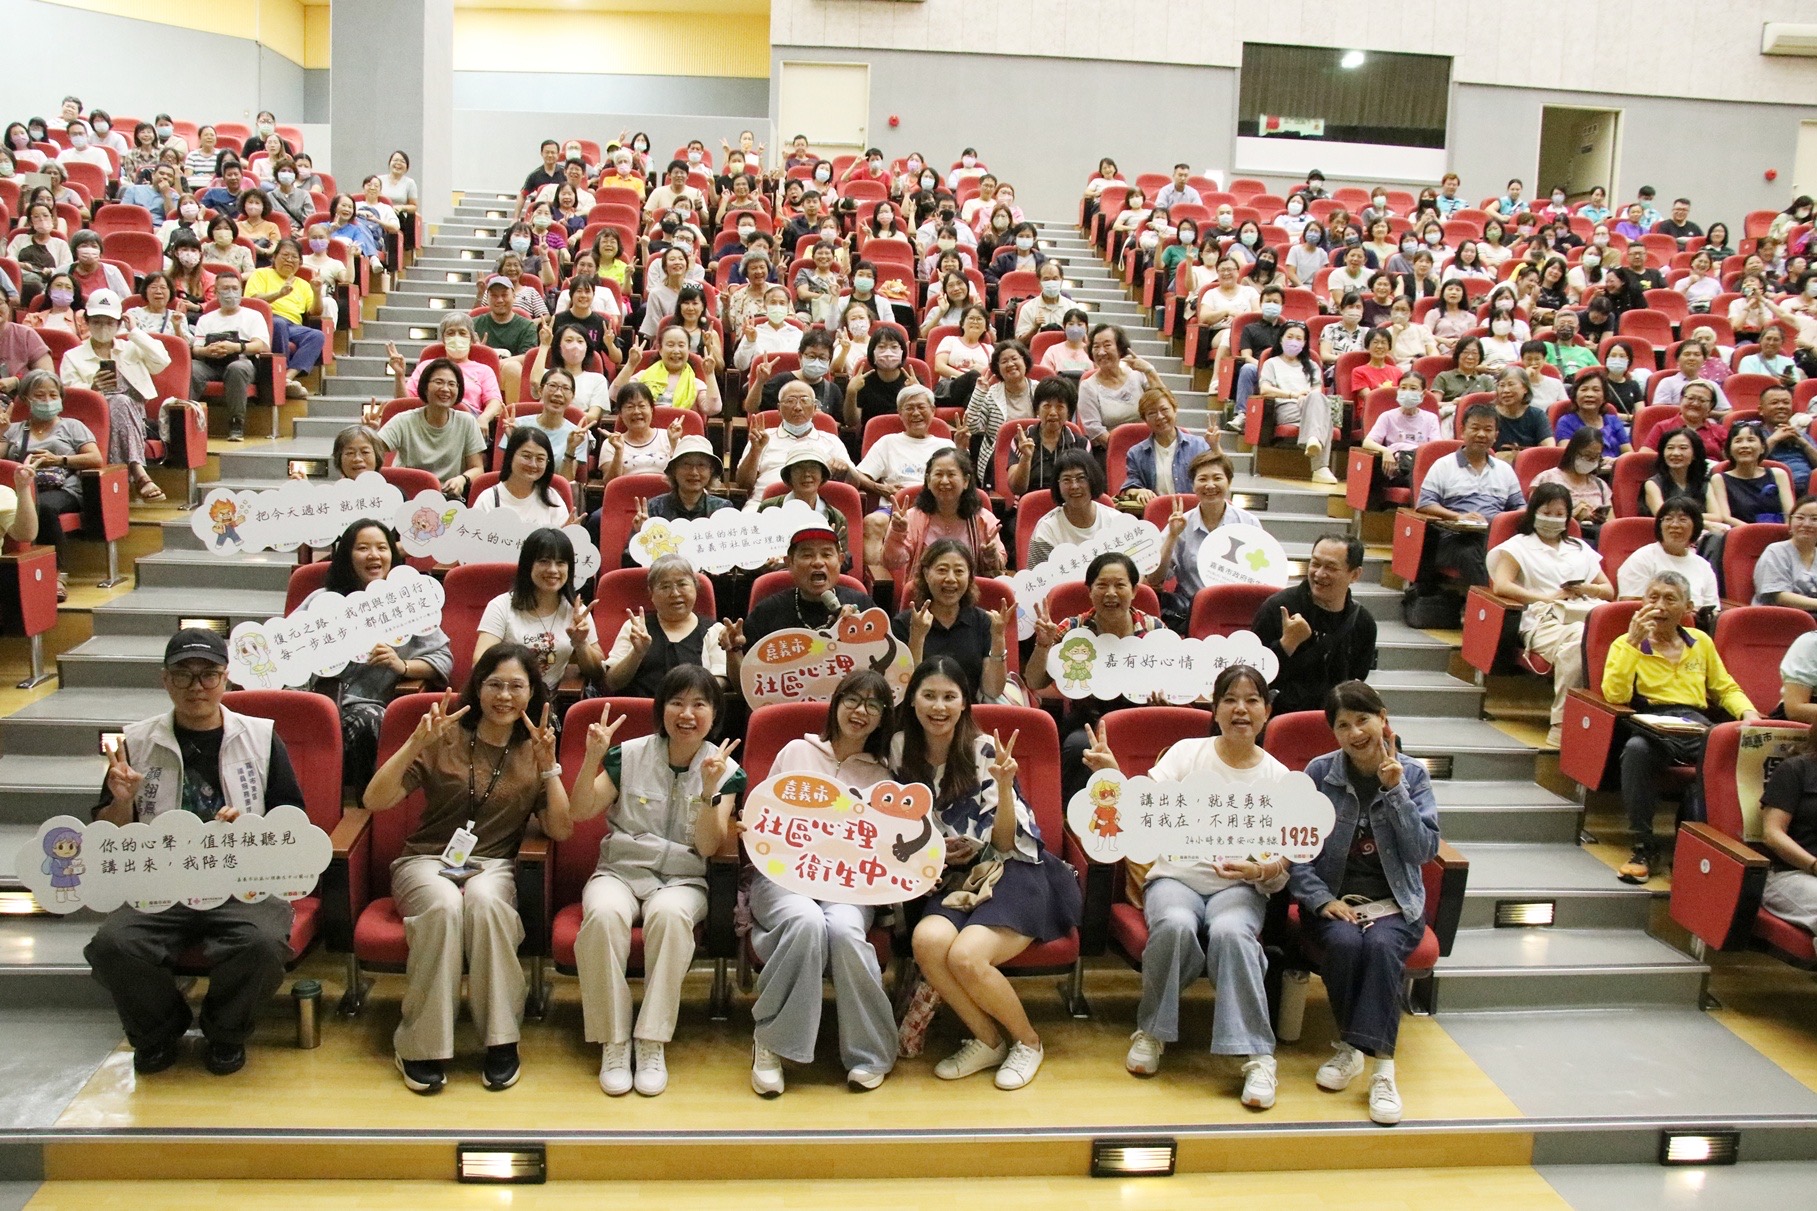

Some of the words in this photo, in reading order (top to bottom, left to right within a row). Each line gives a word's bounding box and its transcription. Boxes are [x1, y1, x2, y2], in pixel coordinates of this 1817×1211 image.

[256, 504, 330, 522] 把今天過好
[339, 496, 383, 512] 就很好
[697, 534, 792, 554] 嘉義市社區心理衛
[766, 638, 806, 662] 嘉義市
[1104, 653, 1194, 670] 嘉有好心情
[754, 654, 855, 697] 社區心理
[781, 779, 829, 803] 嘉義市
[1139, 793, 1274, 809] 講出來，就是勇敢
[754, 808, 879, 849] 社區心理
[1139, 812, 1273, 829] 有我在，不用害怕
[99, 830, 297, 854] 你的心聲，值得被聽見
[1280, 826, 1320, 847] 1925
[101, 853, 239, 874] 講出來，我陪您
[795, 853, 920, 892] 衛生中心
